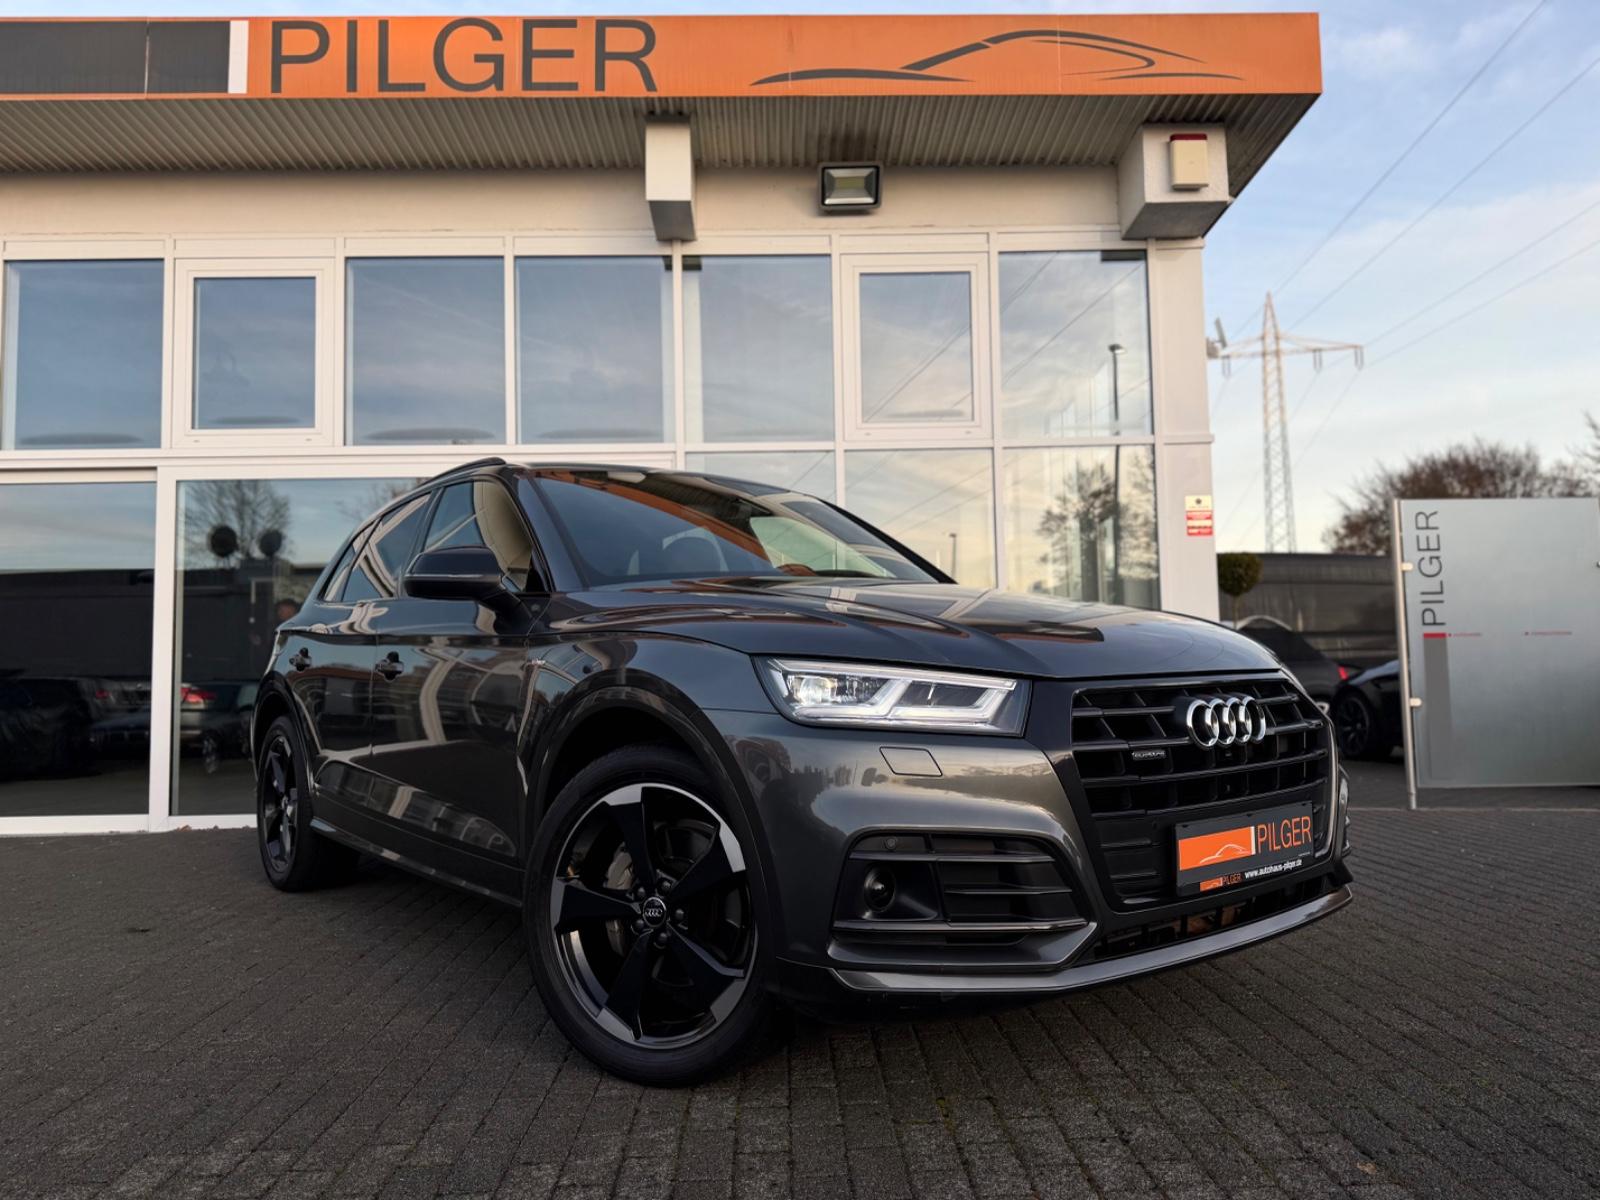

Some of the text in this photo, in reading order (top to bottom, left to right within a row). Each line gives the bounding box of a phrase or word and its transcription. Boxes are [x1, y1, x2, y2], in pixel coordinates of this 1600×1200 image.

[270, 17, 658, 94] PILGER
[1414, 511, 1446, 626] PILGER
[1257, 816, 1312, 853] PILGER
